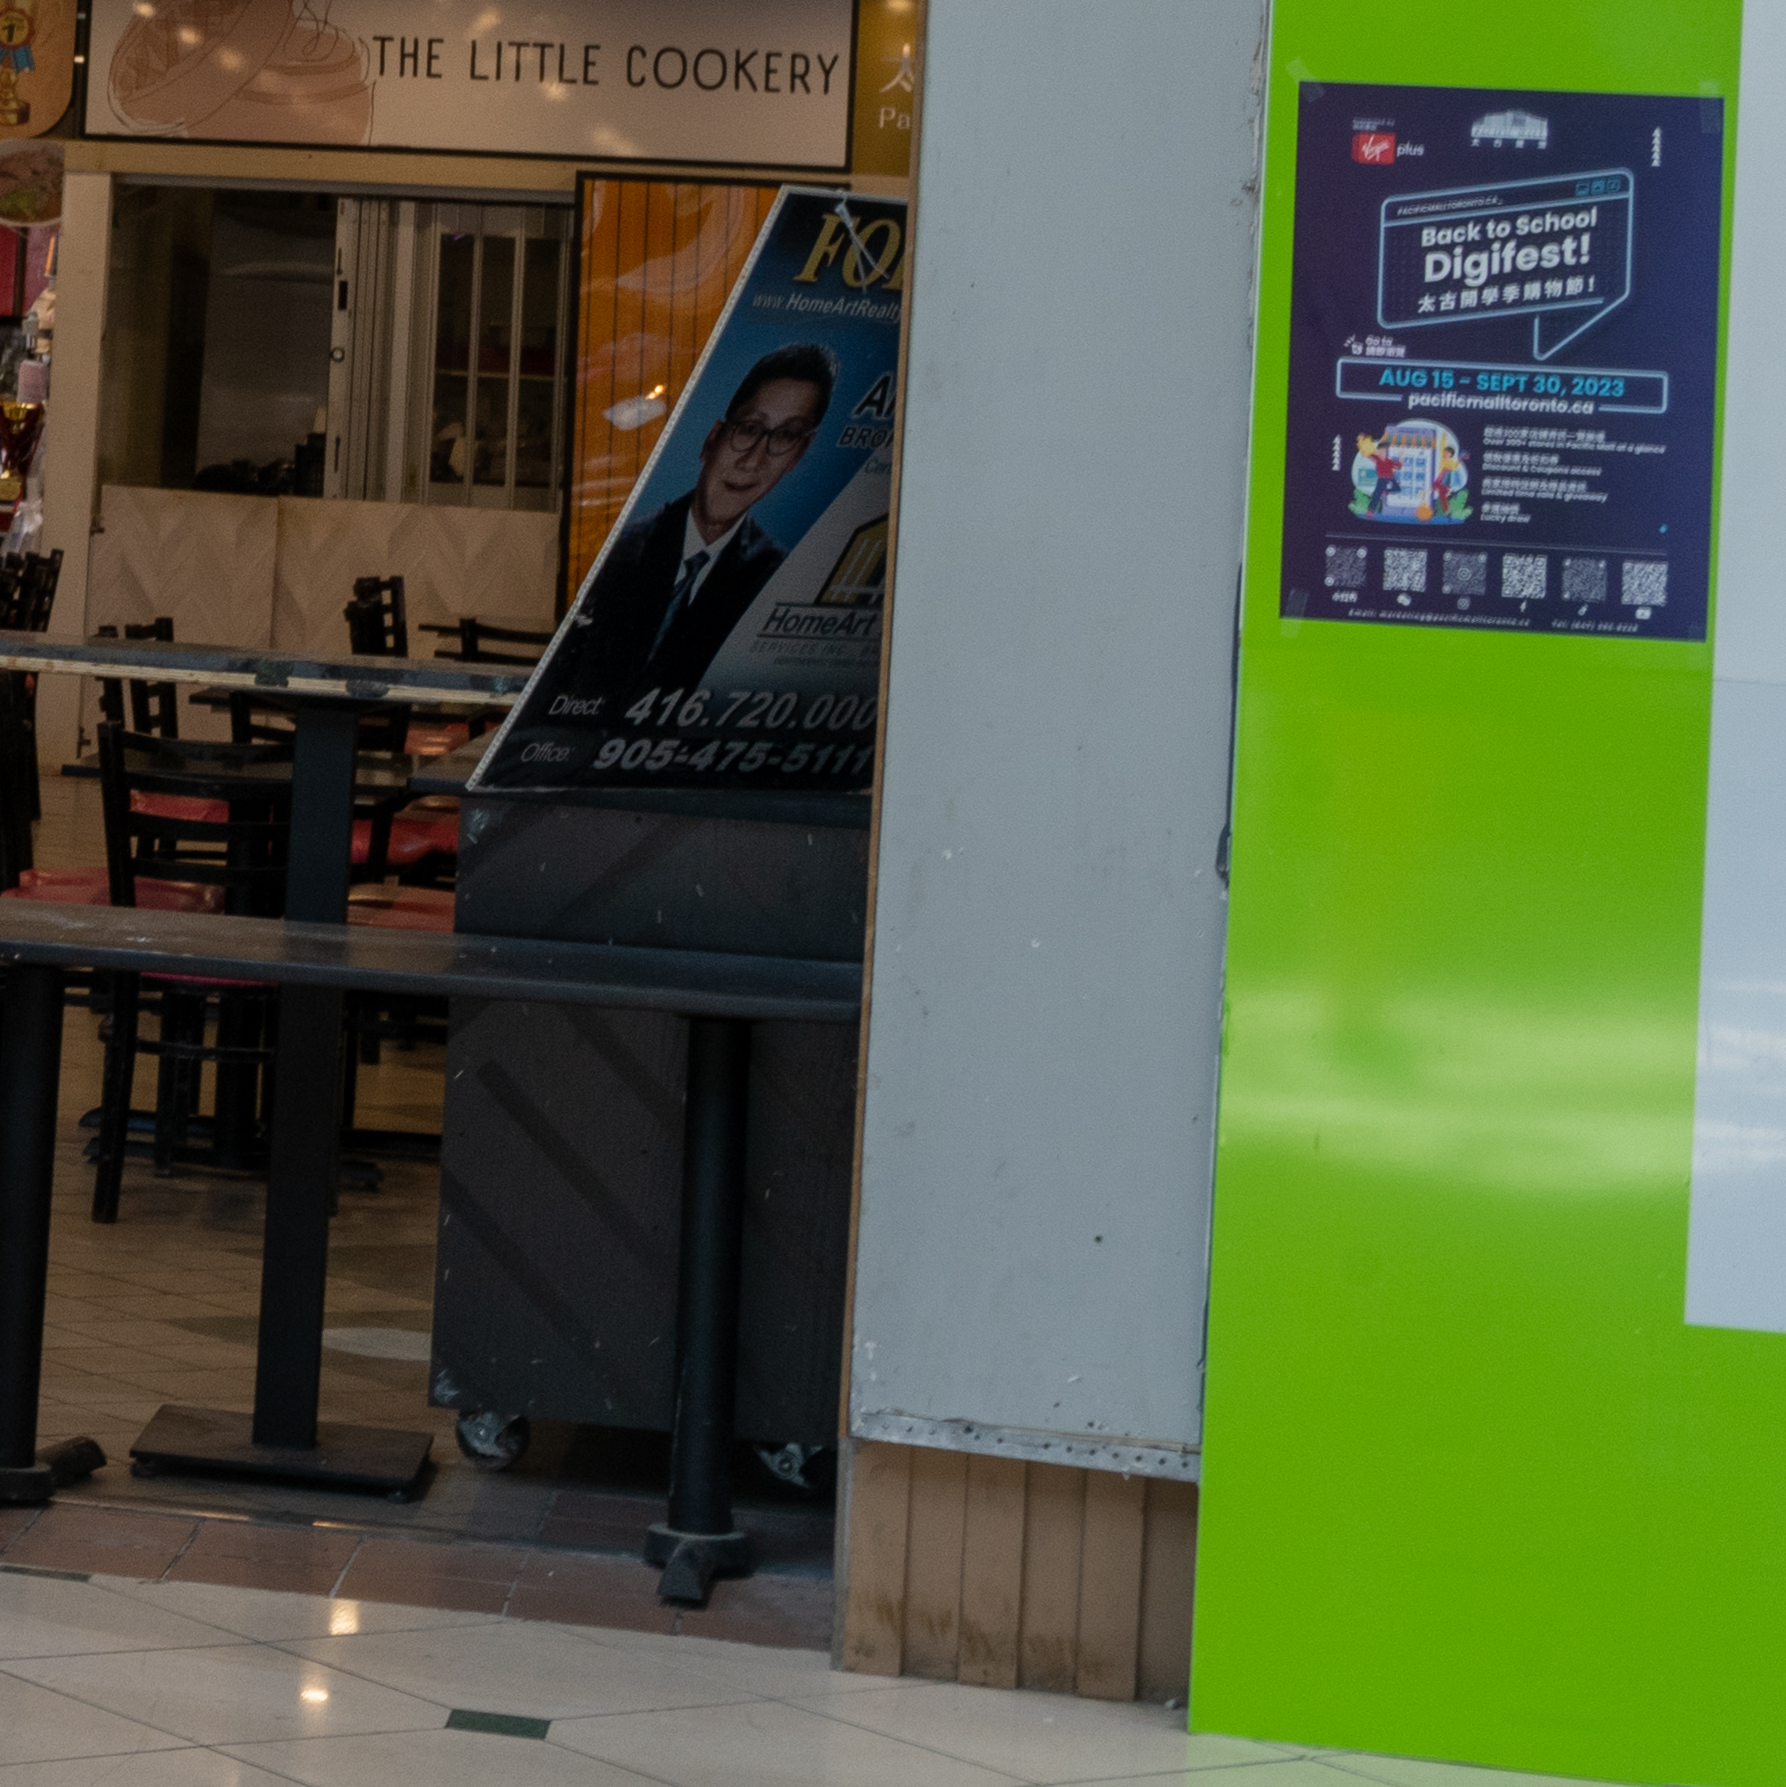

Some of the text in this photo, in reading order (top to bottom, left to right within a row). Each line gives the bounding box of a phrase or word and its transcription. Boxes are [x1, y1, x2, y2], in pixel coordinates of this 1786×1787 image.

[372, 35, 839, 96] THE LITTLE COOKERY
[1396, 140, 1424, 157] plus
[1421, 206, 1598, 248] Back to School
[793, 212, 904, 292] FO
[1423, 234, 1592, 288] Digifest!
[1378, 367, 1428, 389] AUG
[1431, 368, 1454, 389] 15
[1475, 373, 1529, 394] SEPT
[1532, 374, 1567, 398] 30,
[1570, 376, 1626, 398] 2023
[1408, 390, 1594, 415] pacificmalltoronto.ca
[762, 607, 876, 637] HomeArt
